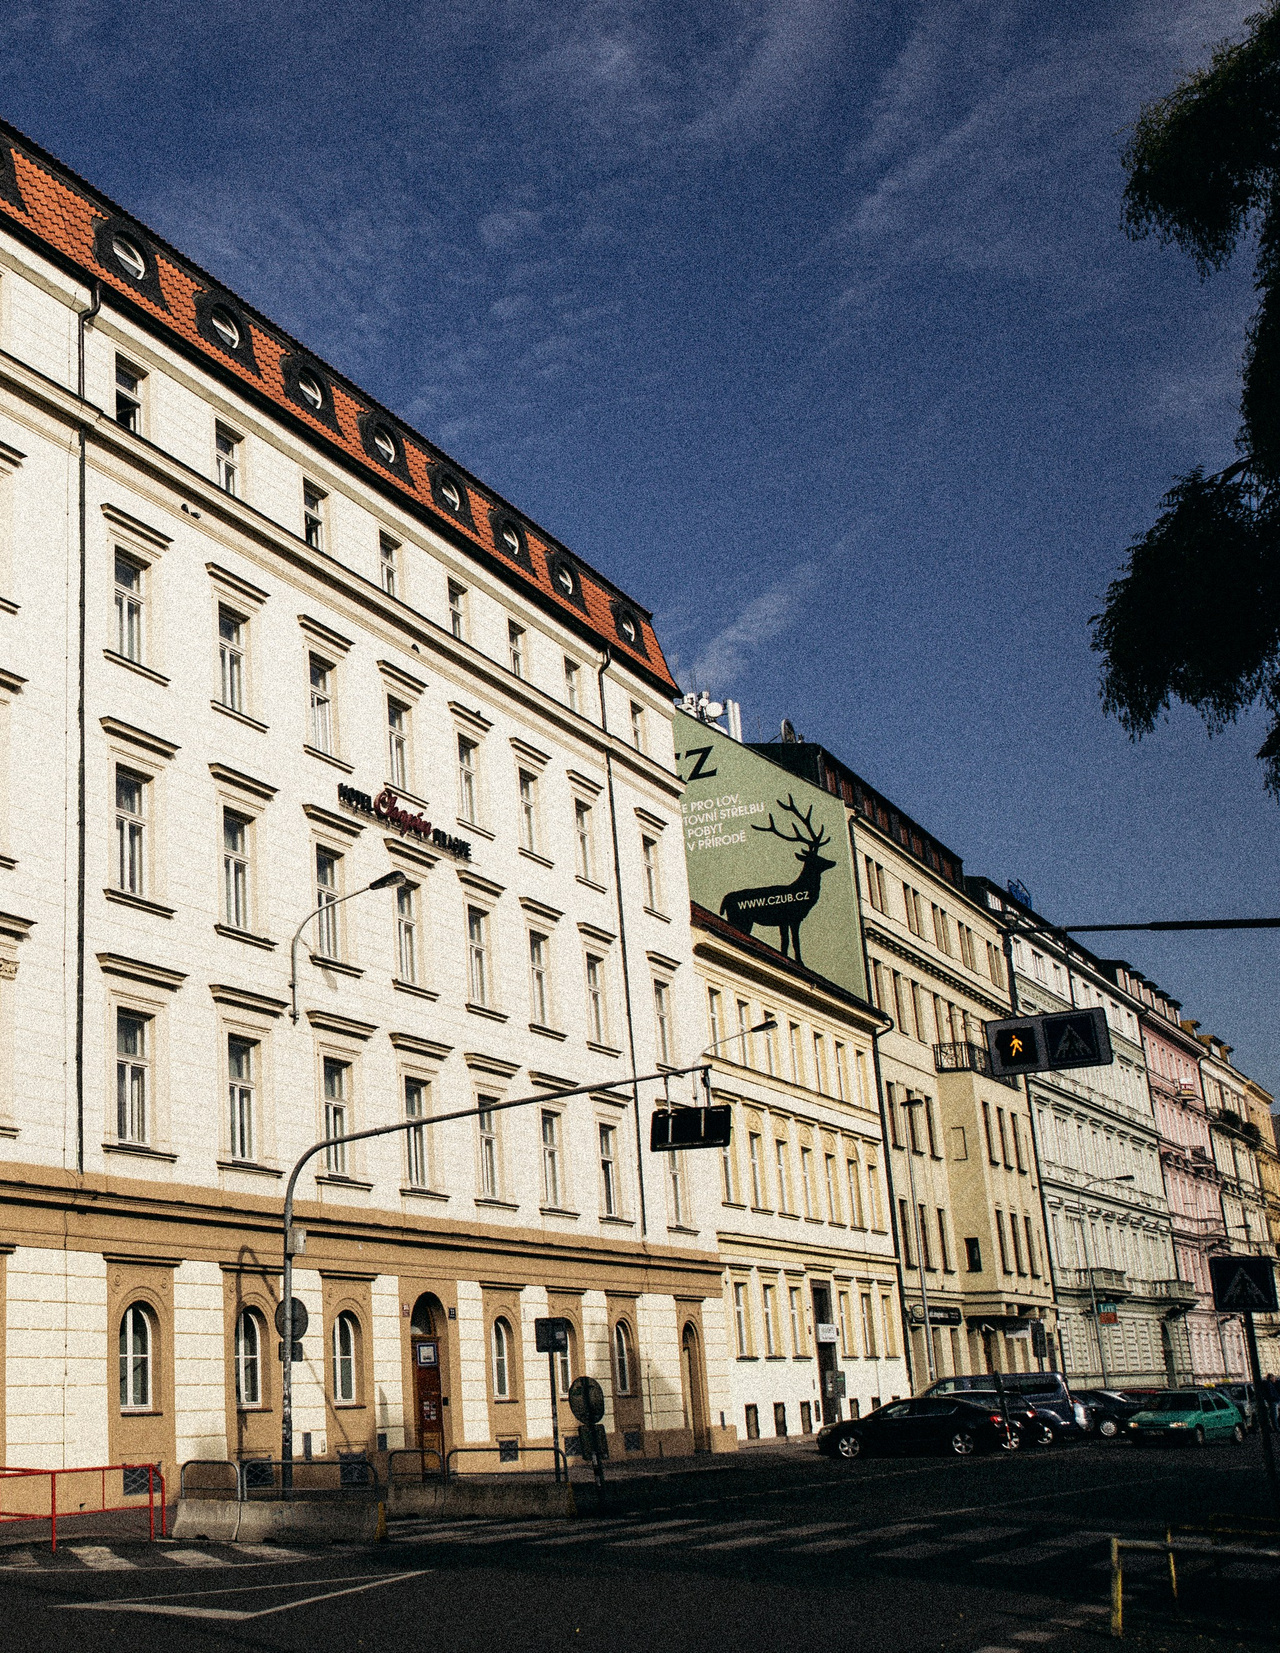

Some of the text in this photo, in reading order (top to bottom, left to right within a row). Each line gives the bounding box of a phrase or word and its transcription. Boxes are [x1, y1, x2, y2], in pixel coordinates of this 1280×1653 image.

[690, 799, 714, 812] PRO
[719, 801, 765, 819] STŘELBU
[687, 822, 723, 839] POBYT
[687, 830, 747, 852] V PŘÍRODĚ
[737, 890, 810, 910] WWW.CZUB.CZ
